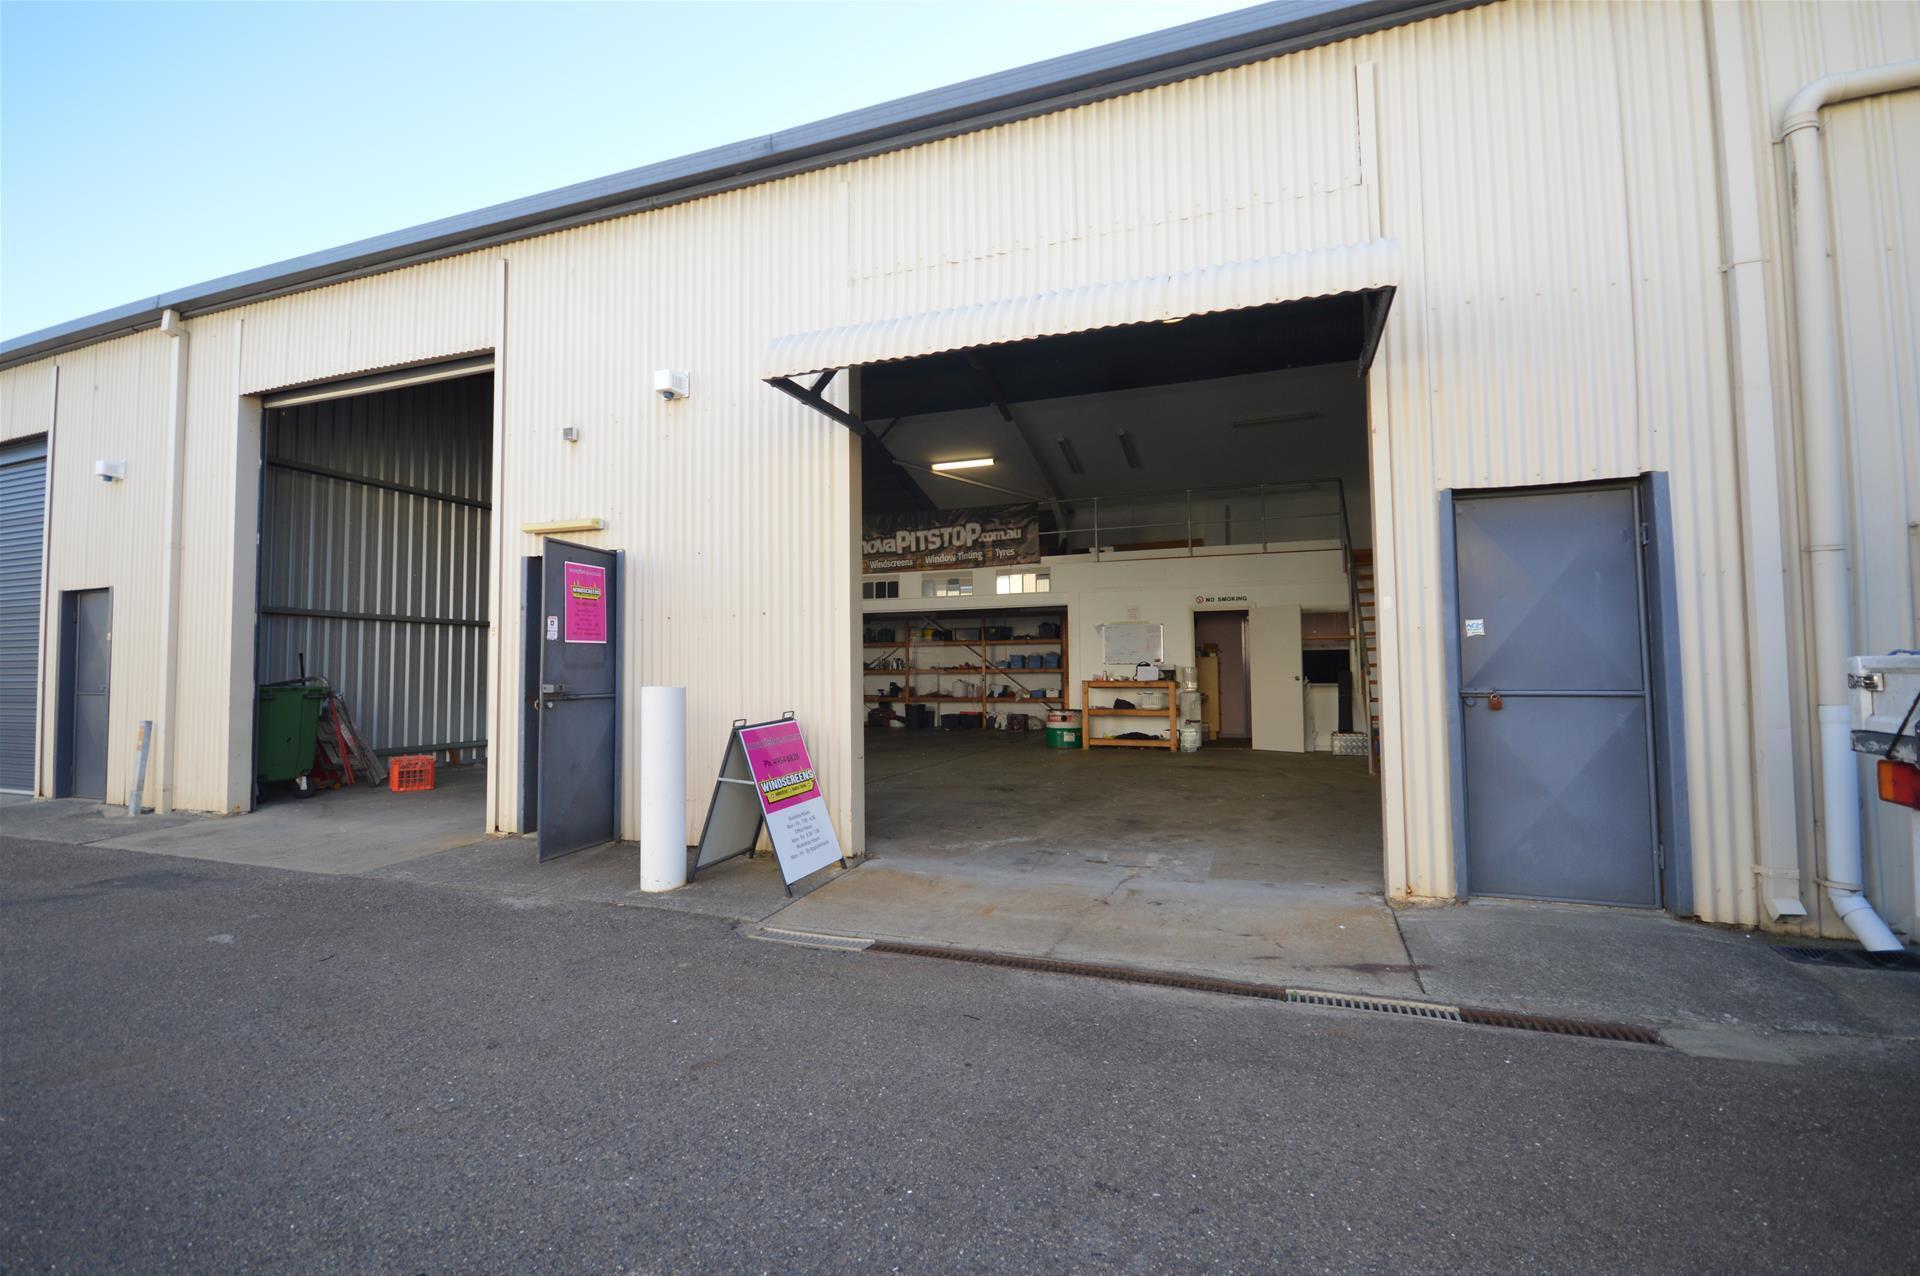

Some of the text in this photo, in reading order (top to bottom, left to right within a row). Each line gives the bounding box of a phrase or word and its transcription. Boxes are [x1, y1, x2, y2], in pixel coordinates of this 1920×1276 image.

[925, 549, 984, 564] Window Tinting
[995, 547, 1016, 559] Tyres
[869, 558, 913, 569] Windscreens
[760, 769, 815, 793] WINDSCREENS
